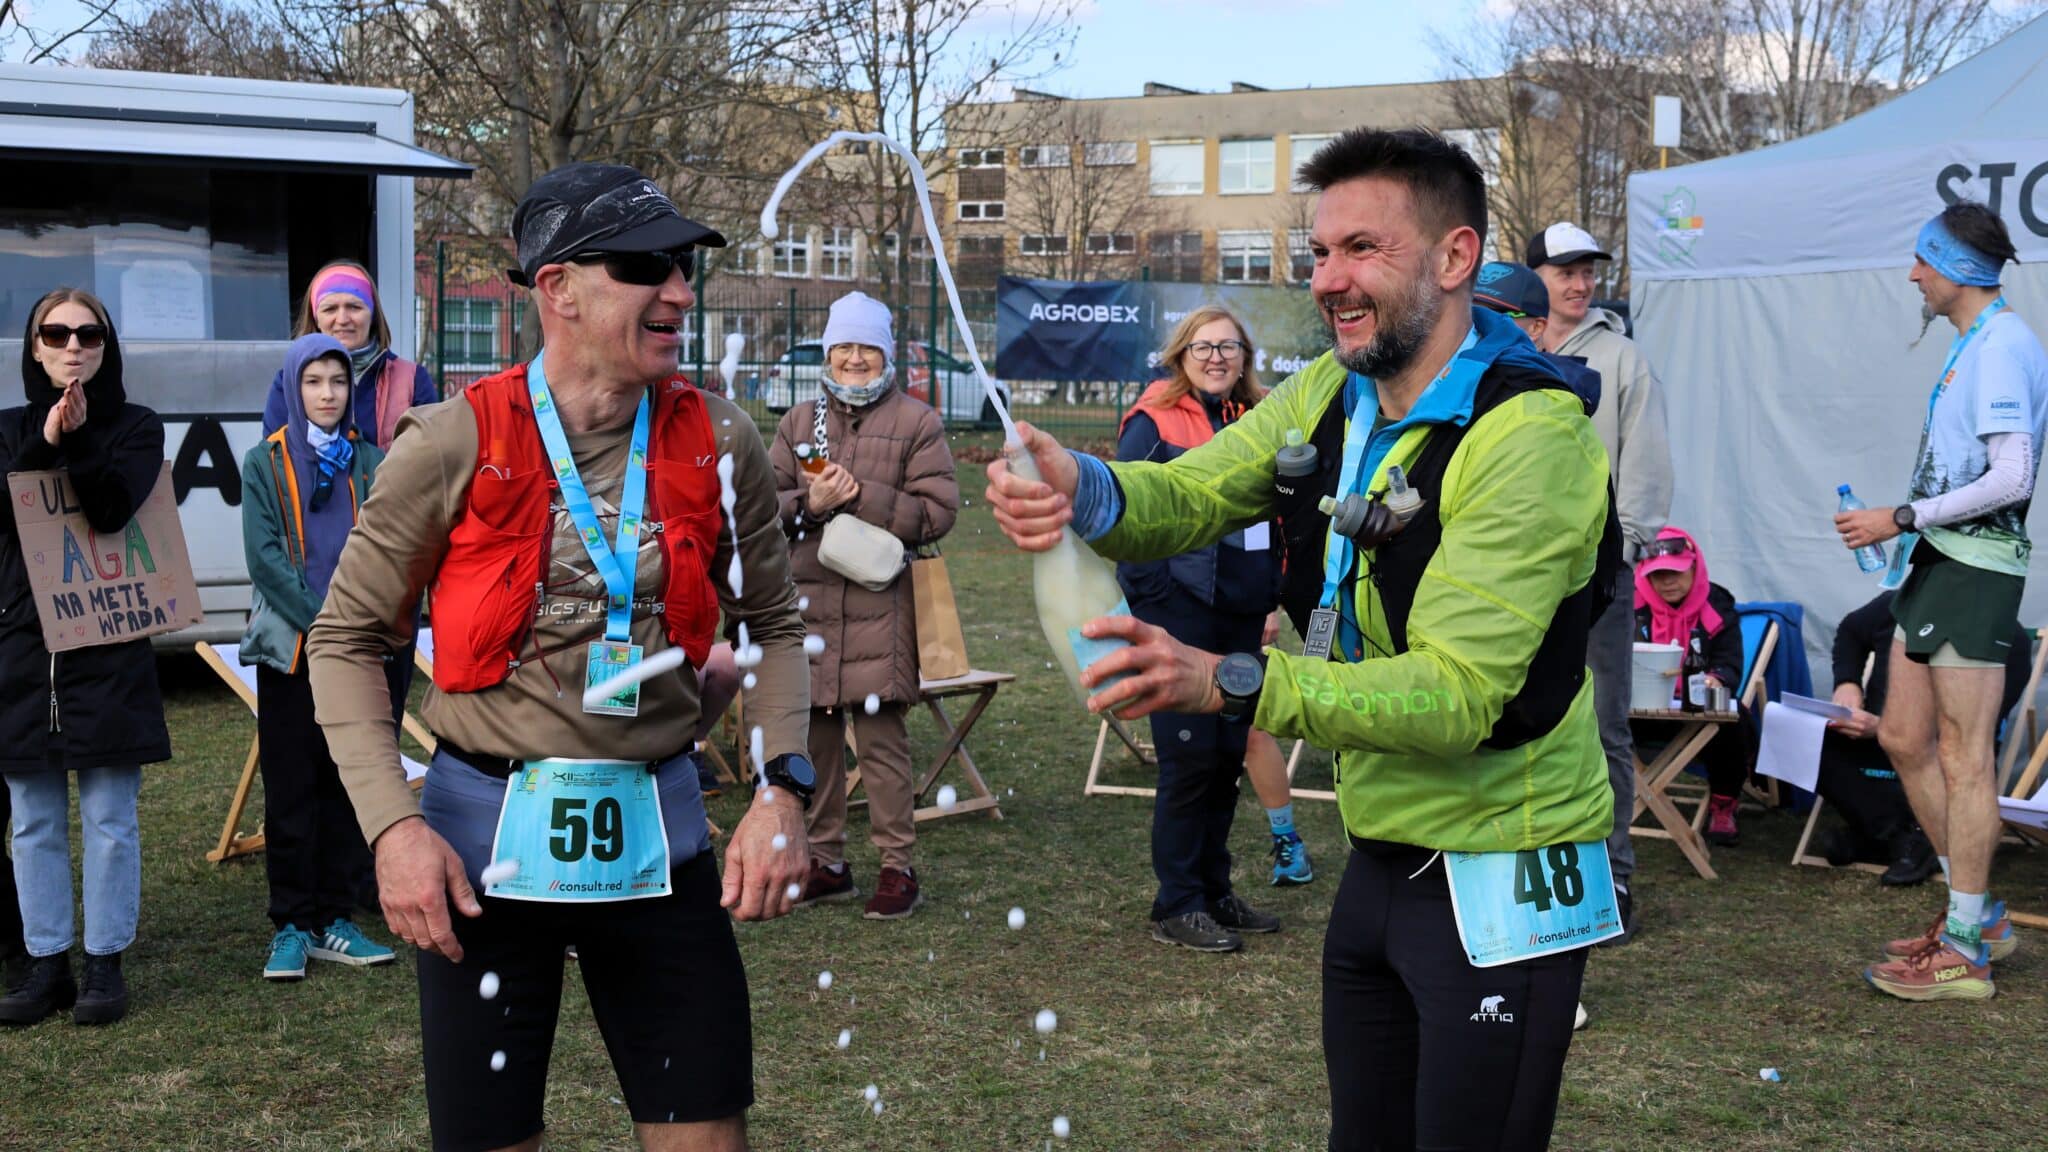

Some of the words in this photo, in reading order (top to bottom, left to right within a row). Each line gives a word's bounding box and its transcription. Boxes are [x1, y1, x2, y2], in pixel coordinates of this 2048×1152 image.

[1029, 304, 1139, 323] AGROBEX
[62, 515, 157, 584] AGA
[52, 591, 84, 620] NA
[88, 582, 149, 609] METĘ
[98, 605, 167, 637] WPADA
[1296, 672, 1457, 716] salomon
[549, 796, 624, 863] 59
[1513, 841, 1584, 913] 48
[1934, 966, 1967, 982] HOKA
[1469, 1012, 1514, 1023] ATTIQ
